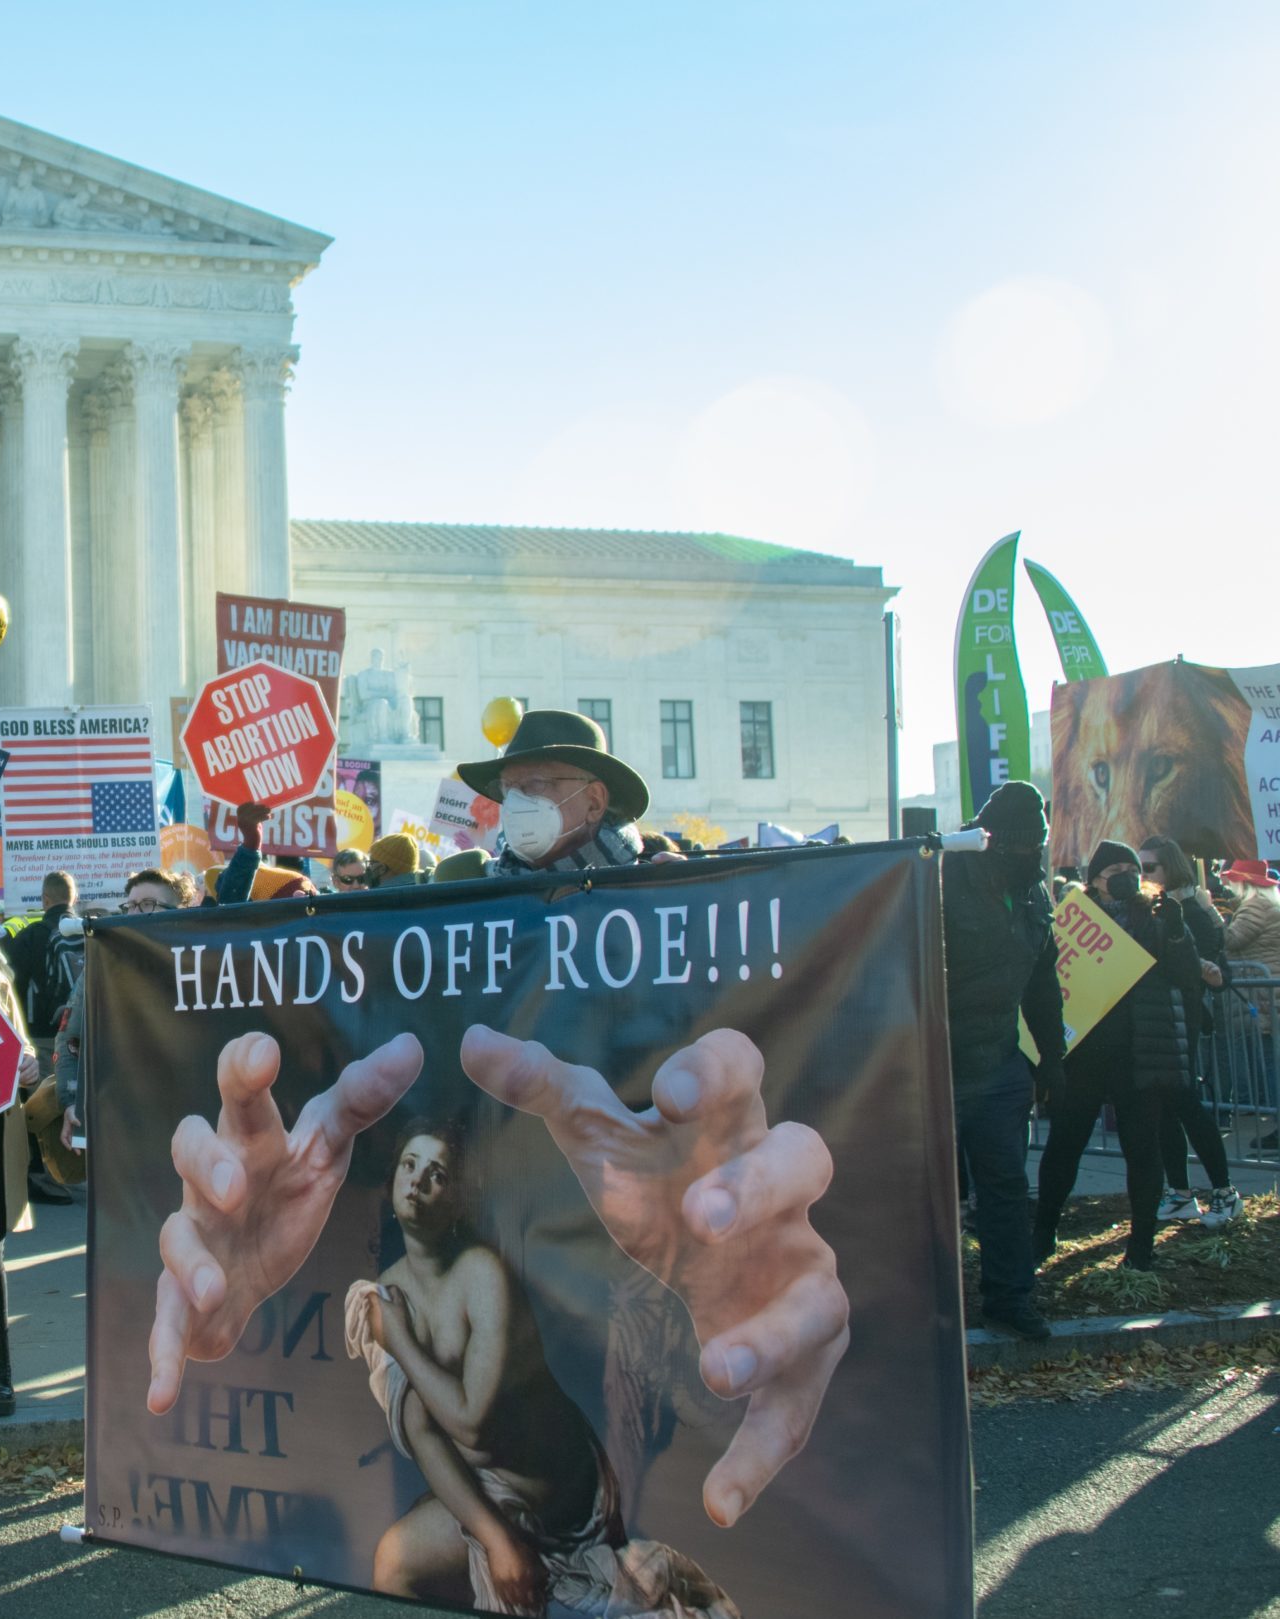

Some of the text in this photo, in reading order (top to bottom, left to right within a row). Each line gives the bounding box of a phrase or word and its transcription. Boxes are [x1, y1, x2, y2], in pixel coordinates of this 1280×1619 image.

[230, 604, 333, 642] I AM FULLY
[224, 639, 341, 678] VACCINATED
[210, 673, 272, 725] STOP
[1244, 686, 1275, 699] THE
[0, 717, 149, 737] GOD BLESS AMERICA?
[201, 702, 320, 778] ABORTION
[242, 751, 304, 802] NOW
[439, 796, 468, 810] RIGHT
[401, 820, 441, 846] MOM
[435, 812, 479, 829] DECISION
[6, 840, 34, 851] MAYBE
[36, 839, 74, 850] AMERICA
[76, 838, 108, 849] SHOULD
[111, 837, 136, 848] BLESS
[138, 836, 157, 846] GOD
[111, 851, 142, 860] kingdom
[10, 864, 26, 872] God
[75, 862, 93, 870] from
[170, 896, 783, 1011] HANDS OFF ROE!!!
[98, 1503, 125, 1529] S.P.
